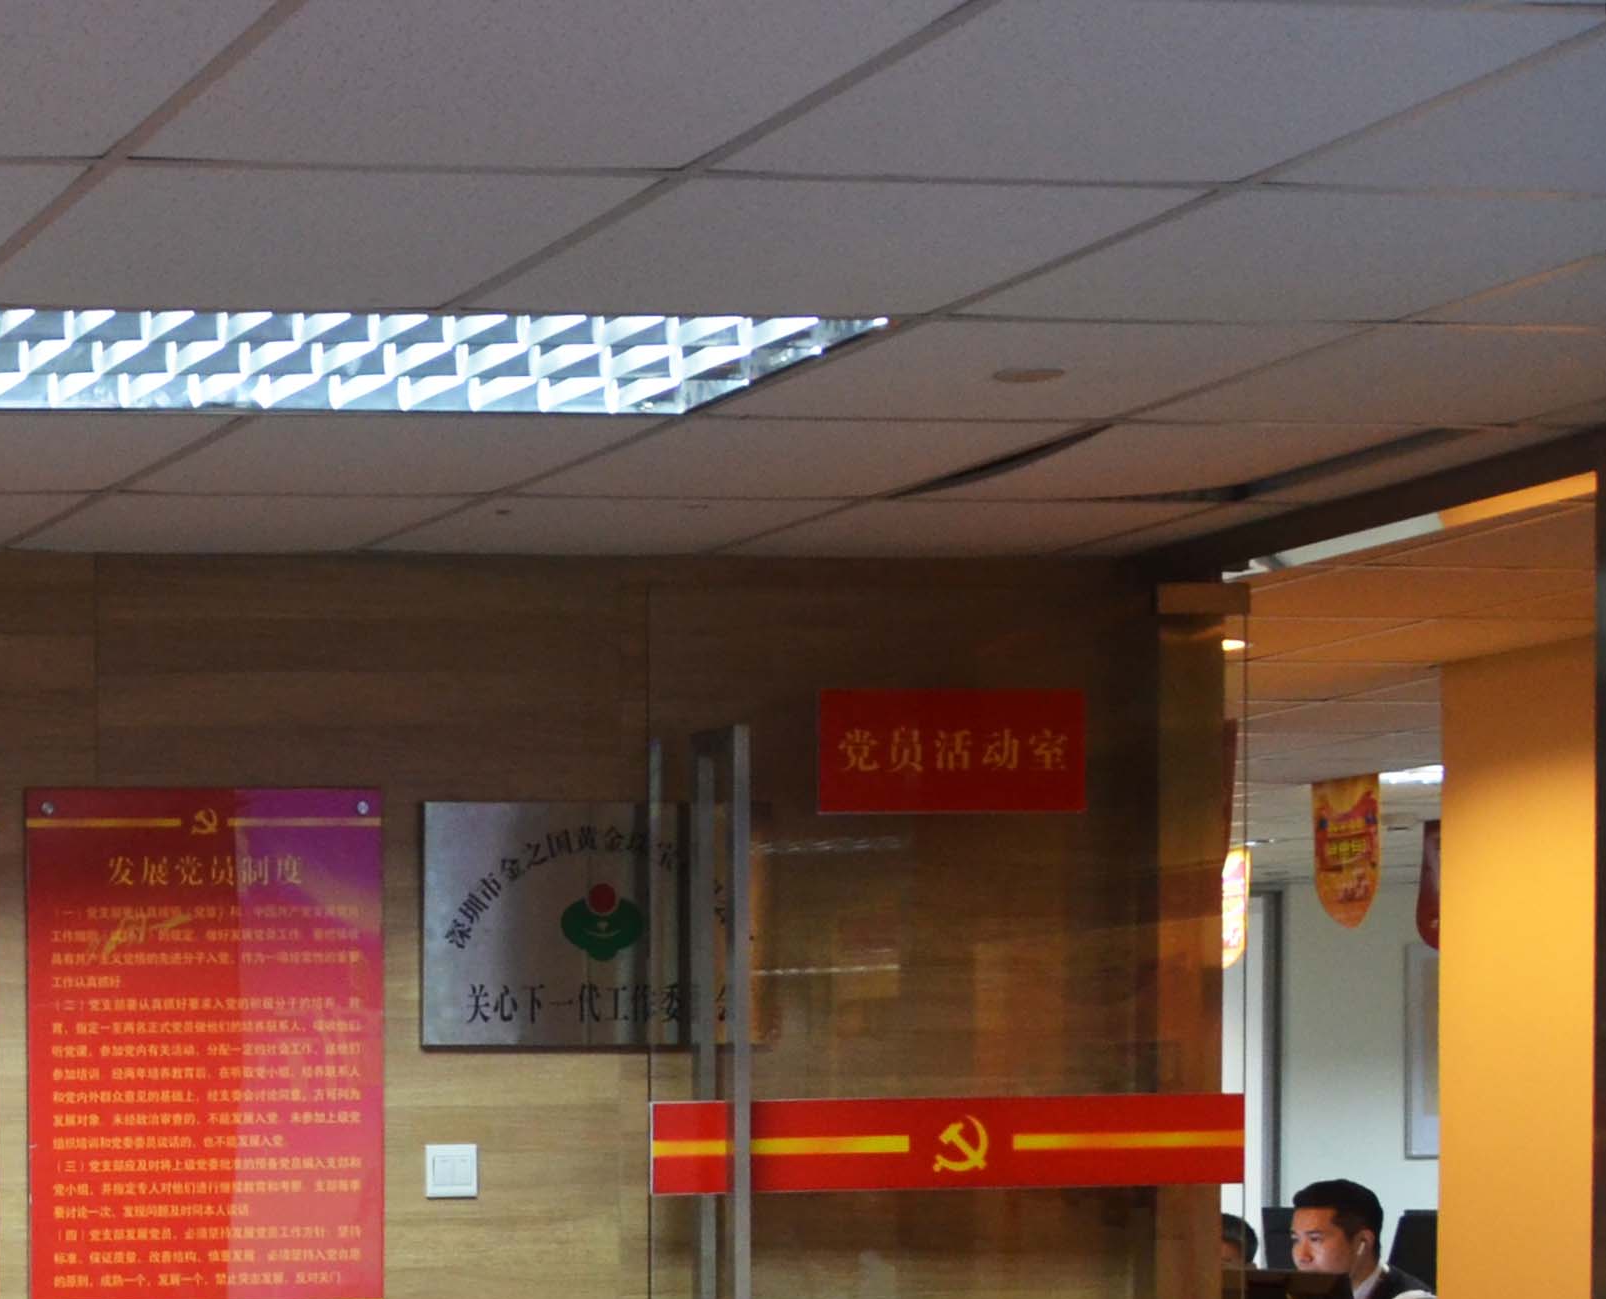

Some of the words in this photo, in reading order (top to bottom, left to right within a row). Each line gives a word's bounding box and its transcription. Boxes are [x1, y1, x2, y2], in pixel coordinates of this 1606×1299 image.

[839, 728, 1068, 772] 党员活动室
[108, 855, 303, 885] 发展党员制度
